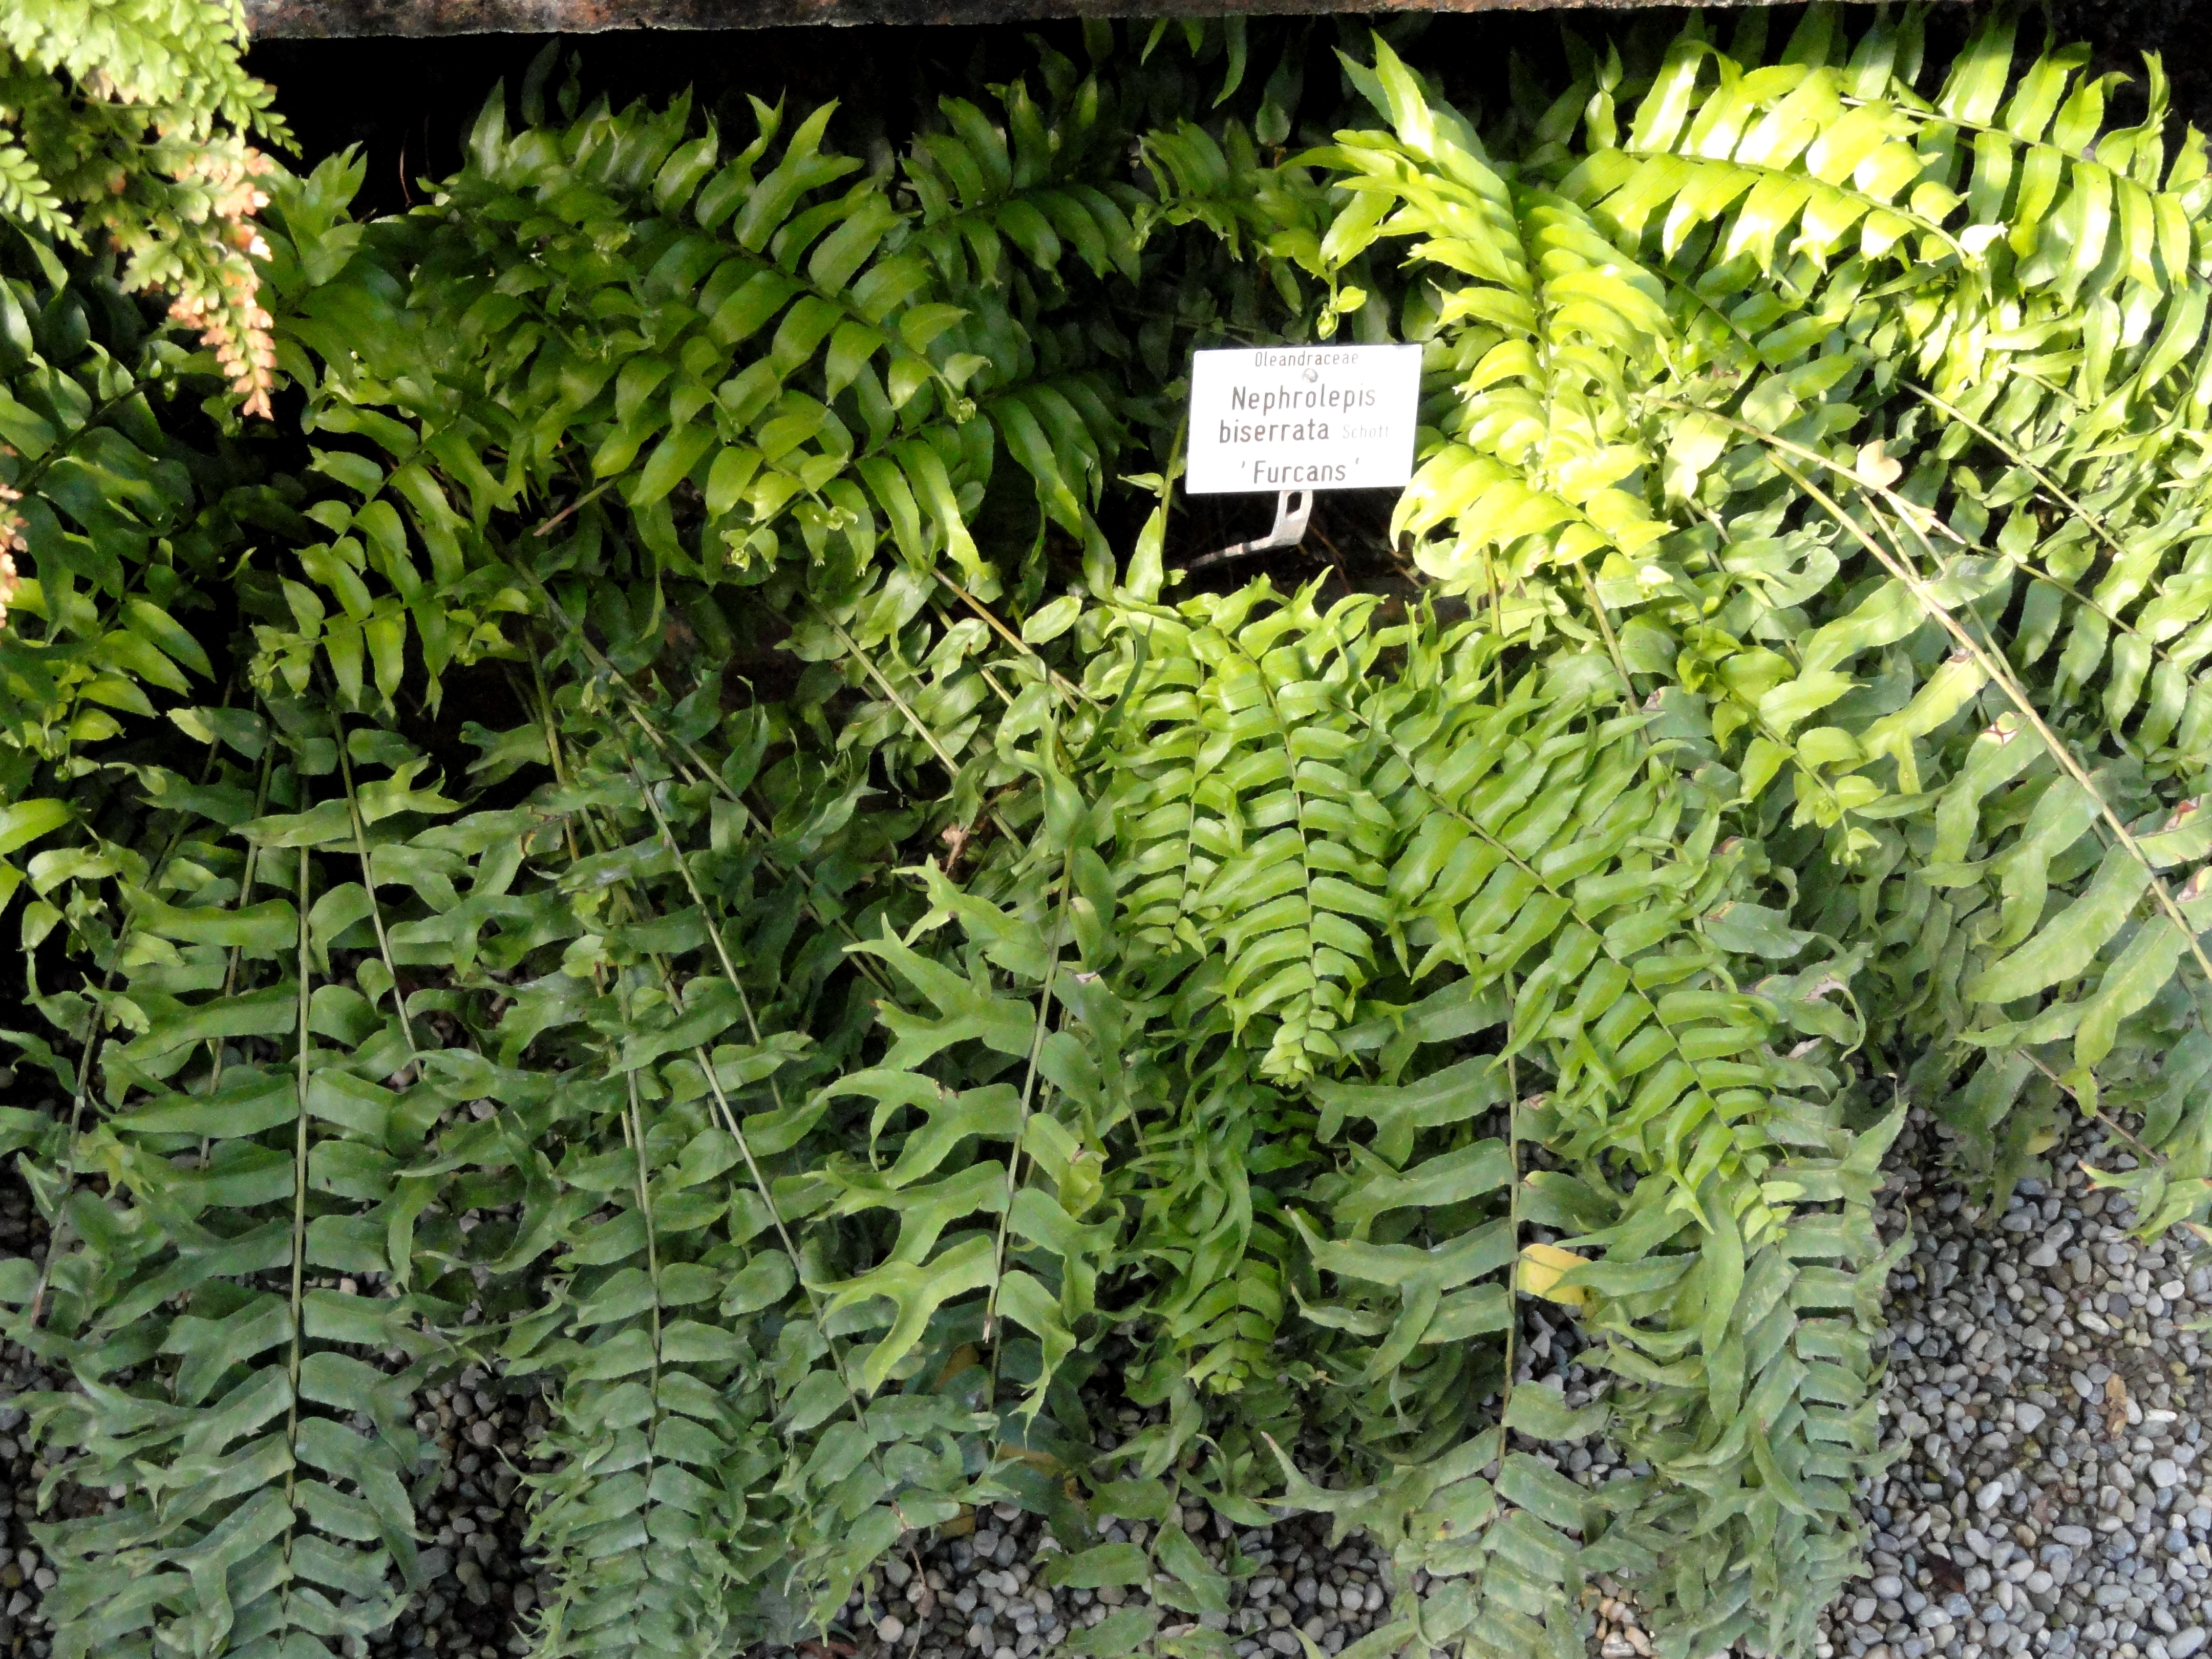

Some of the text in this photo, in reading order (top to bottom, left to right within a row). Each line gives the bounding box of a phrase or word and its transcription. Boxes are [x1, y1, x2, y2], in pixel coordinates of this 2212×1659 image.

[1255, 351, 1359, 367] Oleandraceae
[1232, 383, 1376, 416] Nephrolepis
[1220, 418, 1389, 443] biserrata Schott
